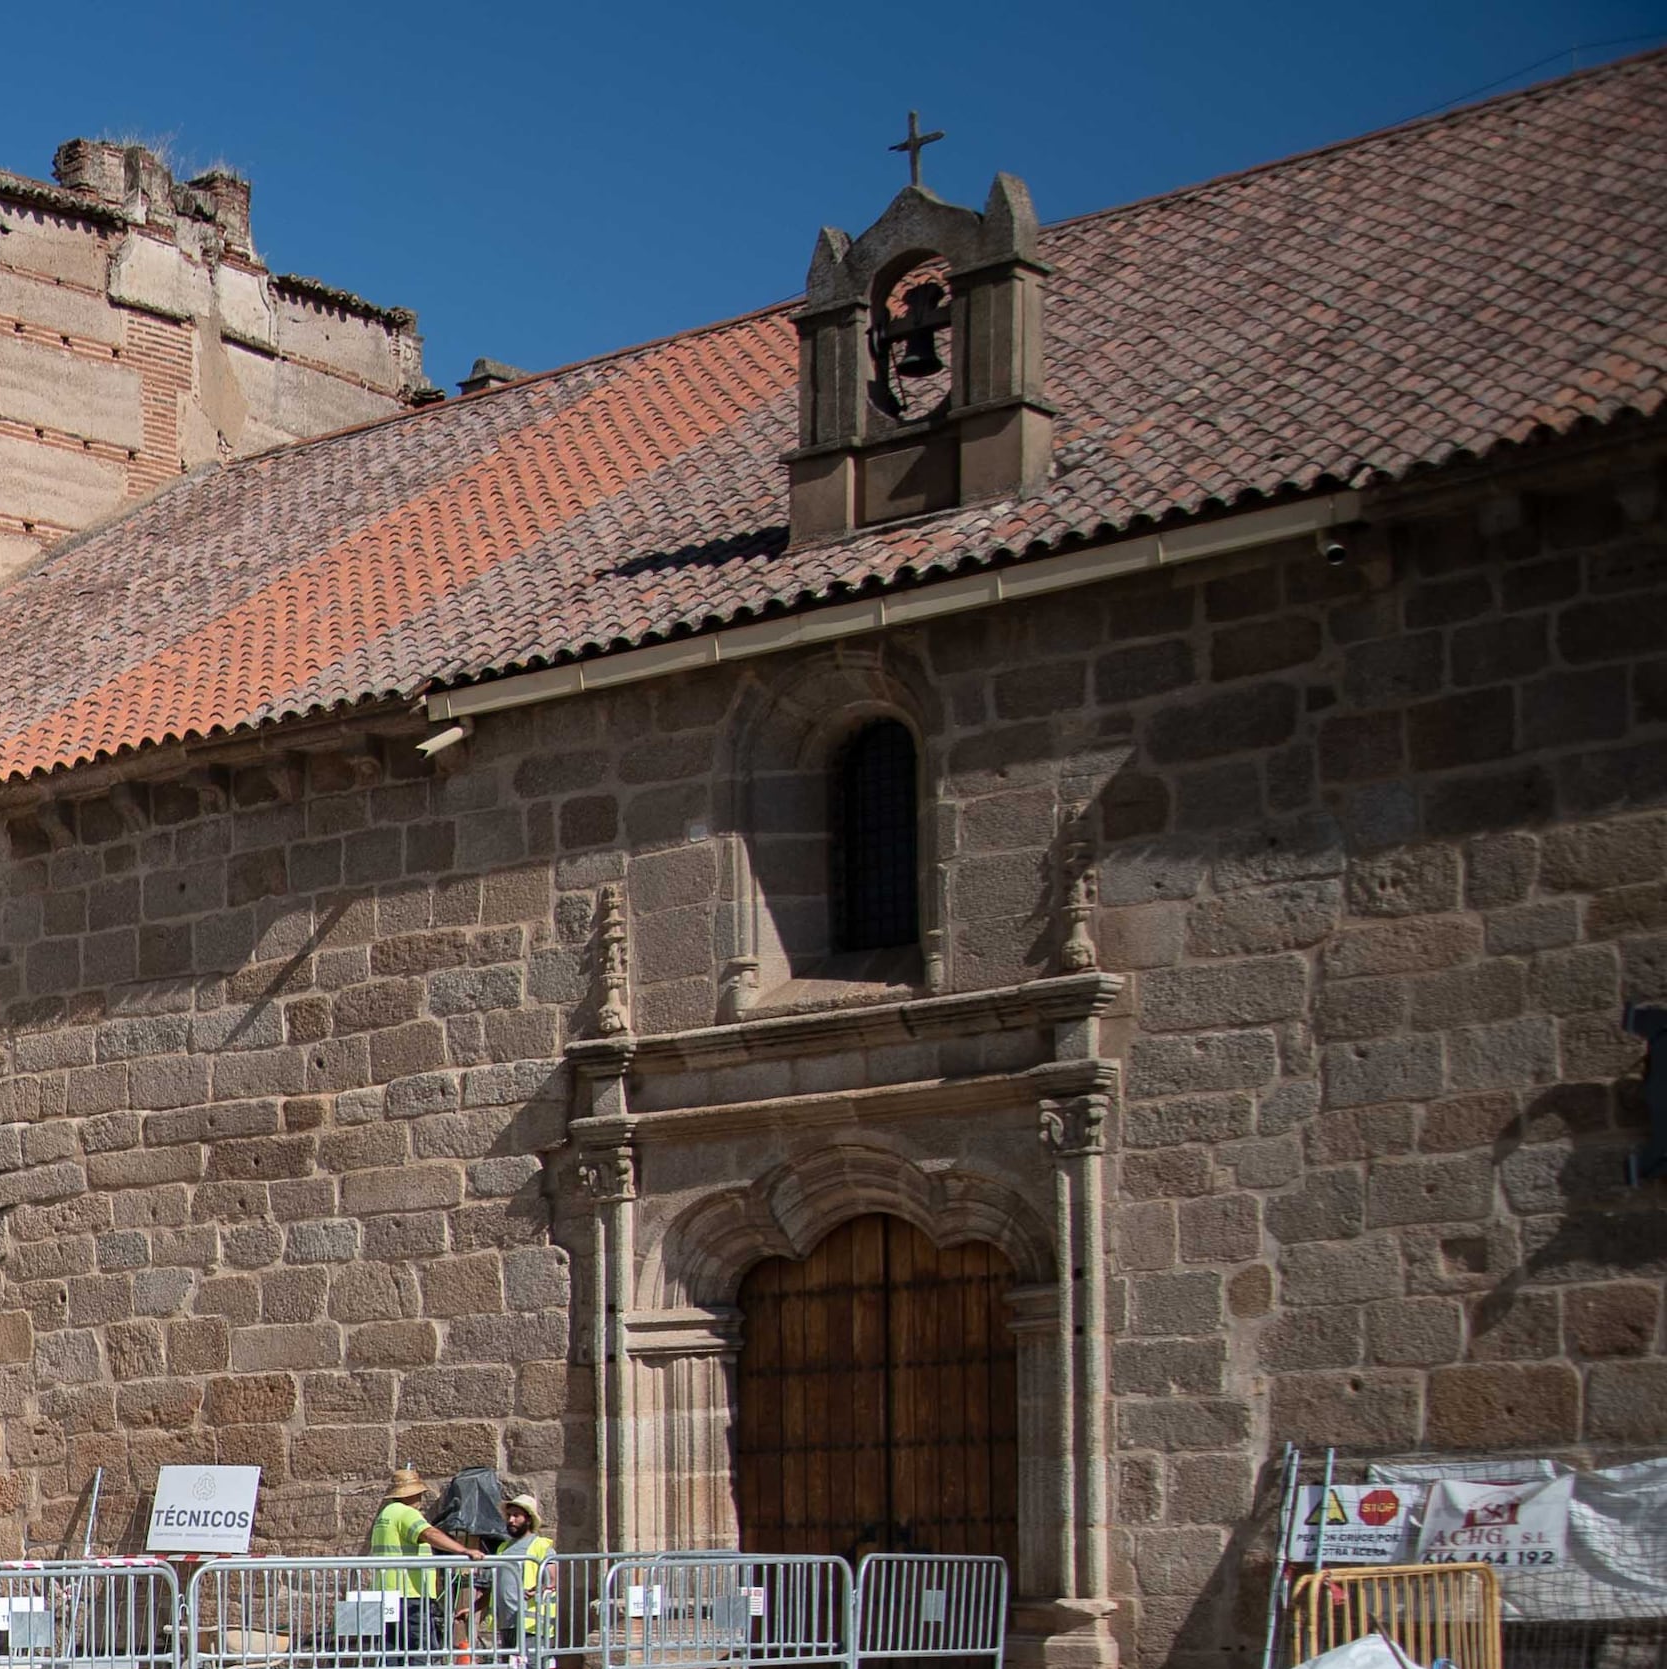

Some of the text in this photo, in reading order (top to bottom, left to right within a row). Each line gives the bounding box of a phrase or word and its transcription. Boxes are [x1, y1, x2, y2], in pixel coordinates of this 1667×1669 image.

[1362, 1502, 1396, 1513] STOP
[154, 1504, 249, 1528] TÉCNICOS
[1297, 1534, 1337, 1542] PEAON
[1339, 1533, 1375, 1542] CRUCE
[1517, 1550, 1555, 1565] 192
